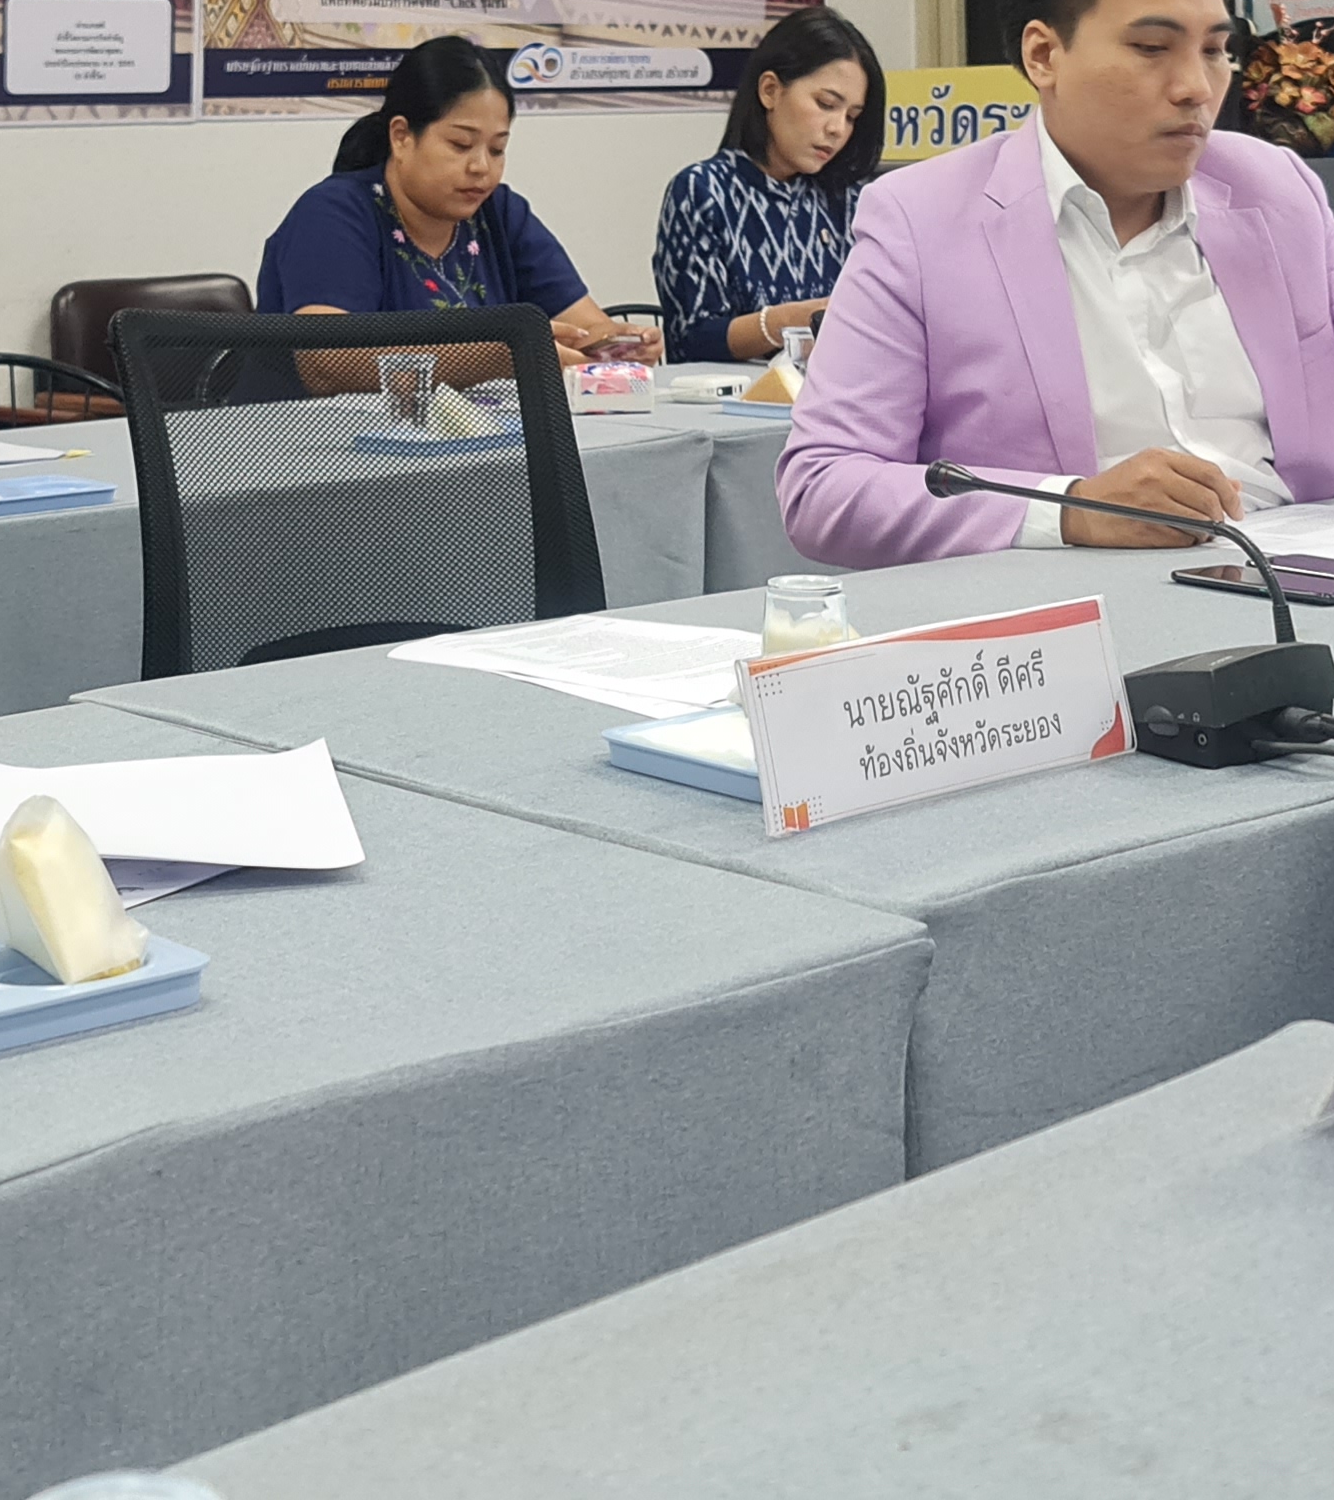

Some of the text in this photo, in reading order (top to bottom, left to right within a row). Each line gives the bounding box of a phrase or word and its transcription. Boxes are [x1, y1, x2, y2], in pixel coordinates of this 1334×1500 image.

[843, 648, 1046, 729] นายณัฐศักดิ์ ดีศรี
[859, 710, 1062, 781] ท้องถิ่นจังหวัดระยอง
